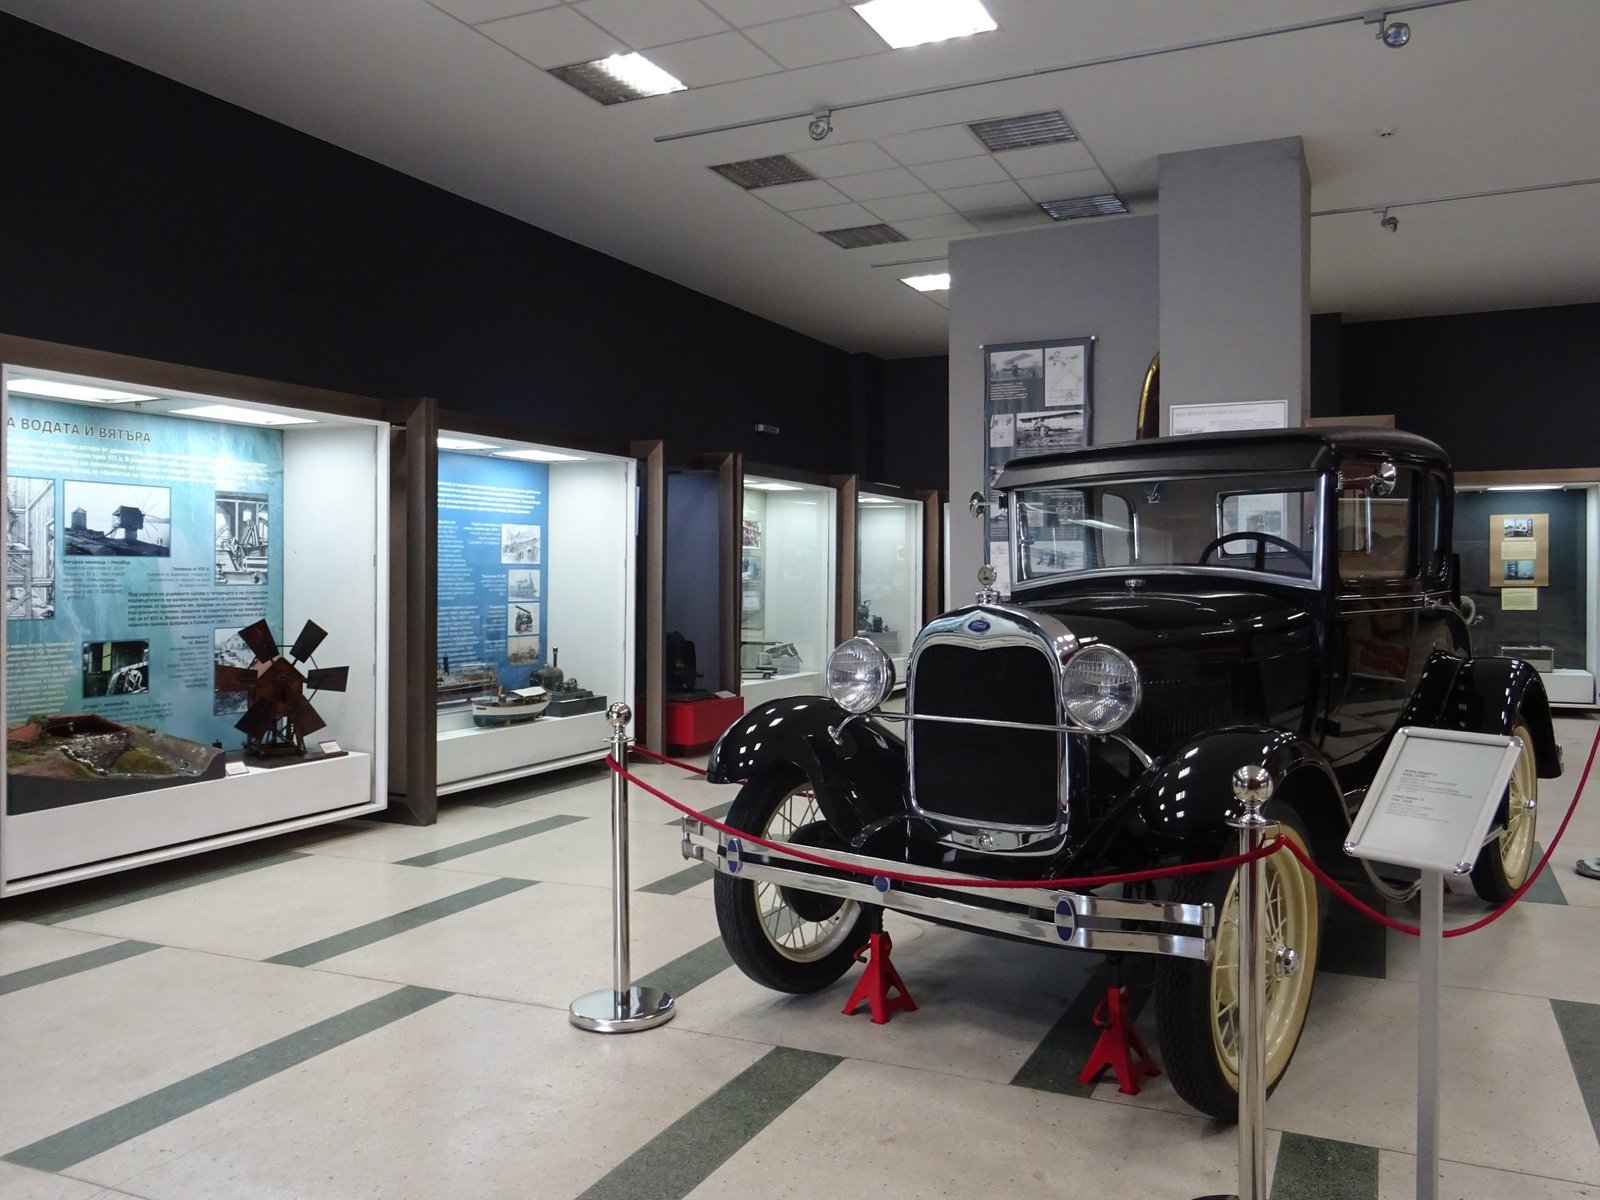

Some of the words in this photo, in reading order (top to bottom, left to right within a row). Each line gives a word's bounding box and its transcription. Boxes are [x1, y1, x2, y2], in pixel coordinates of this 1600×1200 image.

[21, 418, 80, 435] ВОДАТА
[85, 426, 95, 437] И
[99, 427, 151, 443] ВЯТЪРА
